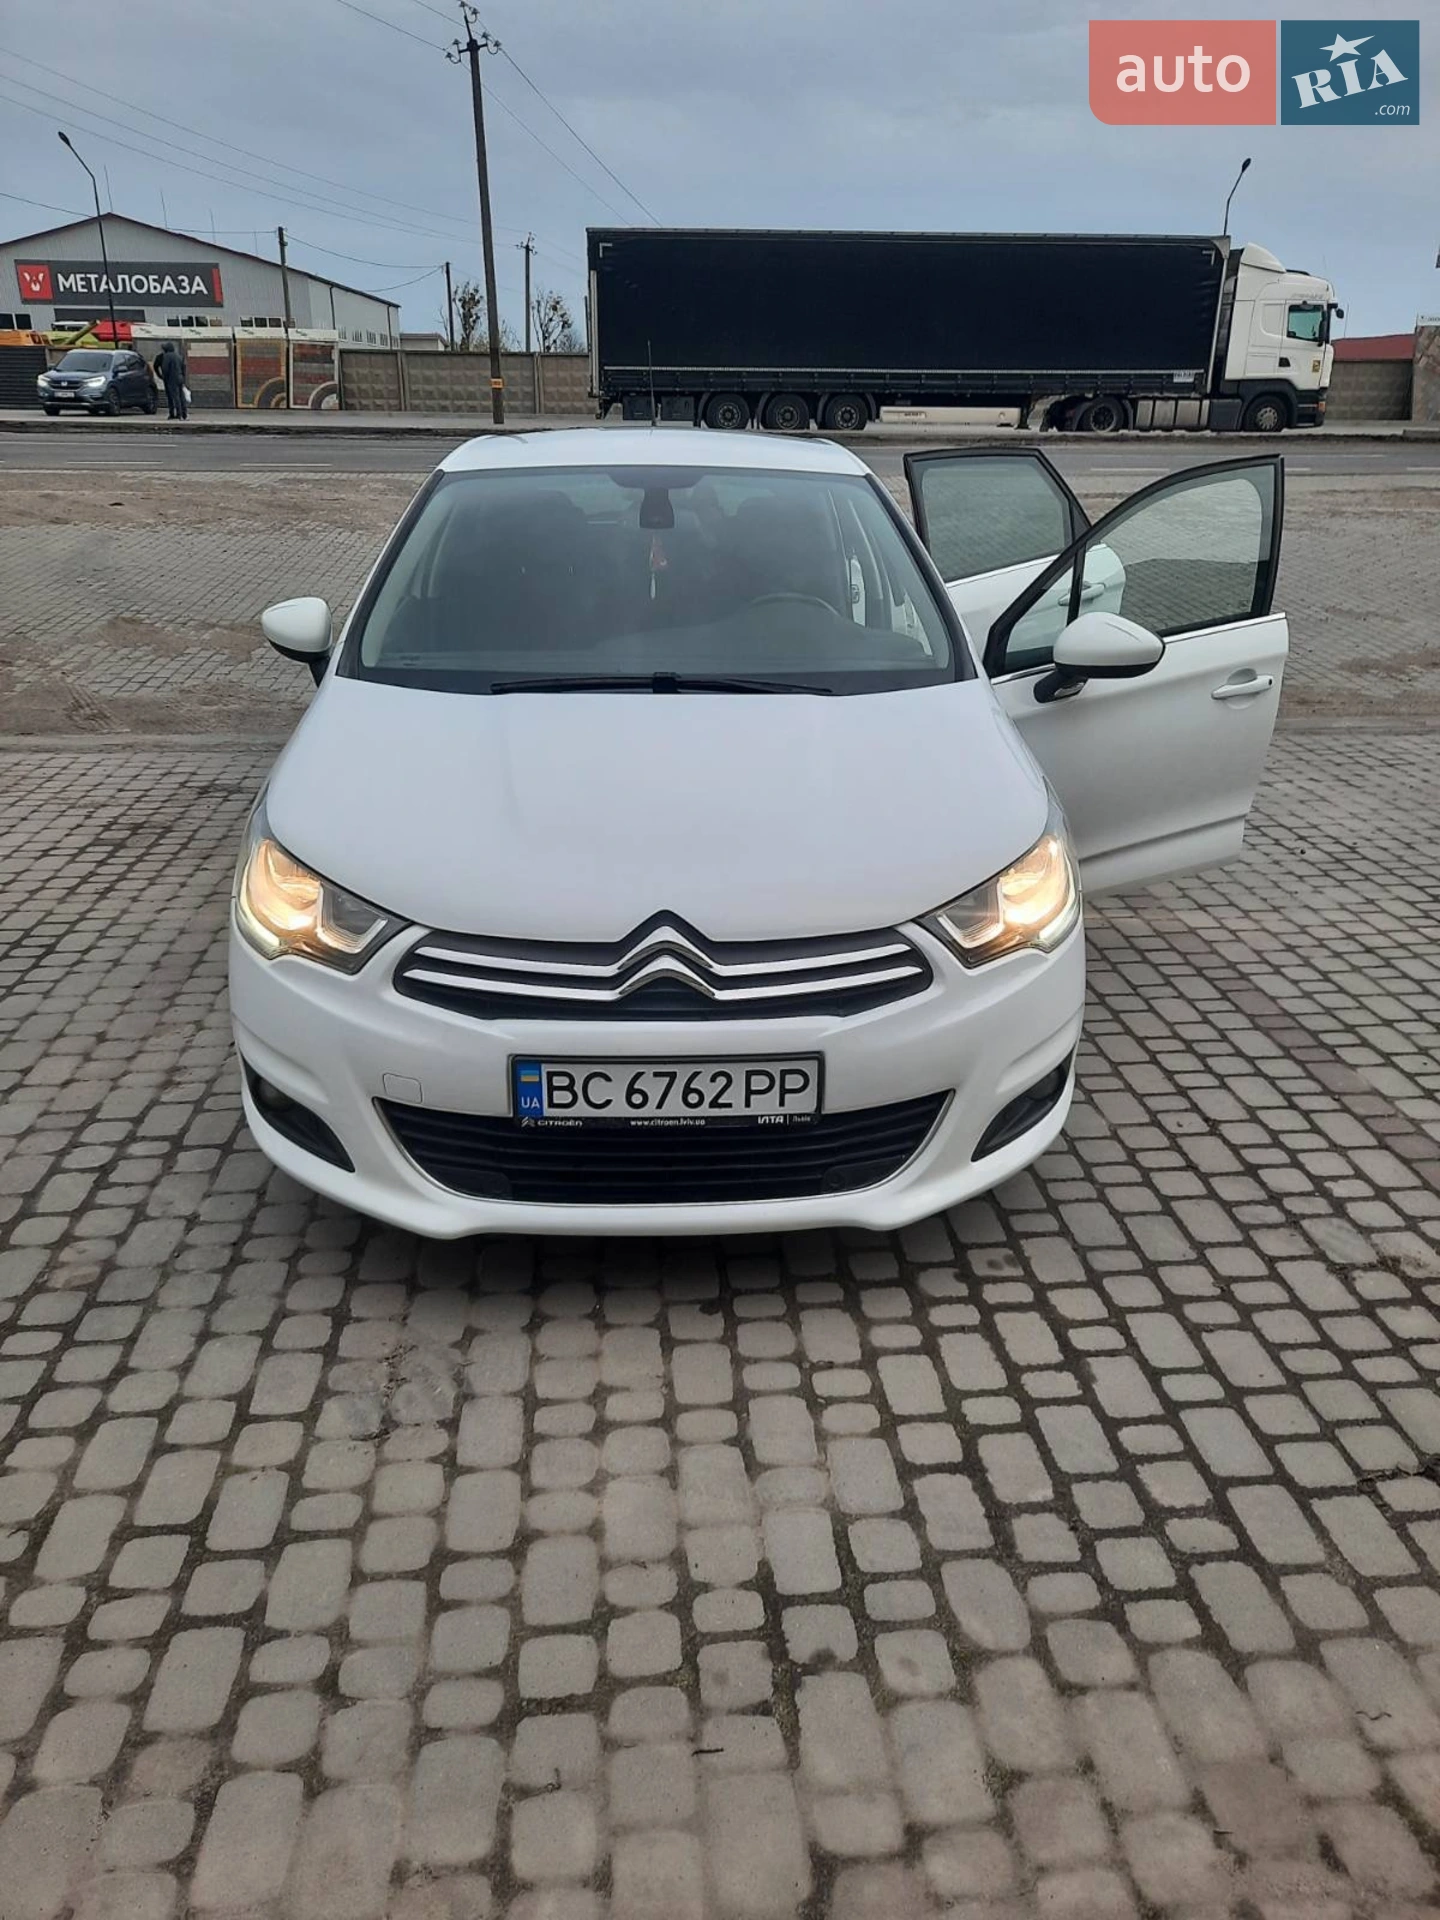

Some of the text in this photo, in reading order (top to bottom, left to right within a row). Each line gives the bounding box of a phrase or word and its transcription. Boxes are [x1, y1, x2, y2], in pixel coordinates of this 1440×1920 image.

[56, 273, 209, 295] МЕТАЛОБАЗА
[546, 1068, 811, 1110] BC 6762 PP
[520, 1097, 540, 1109] UA
